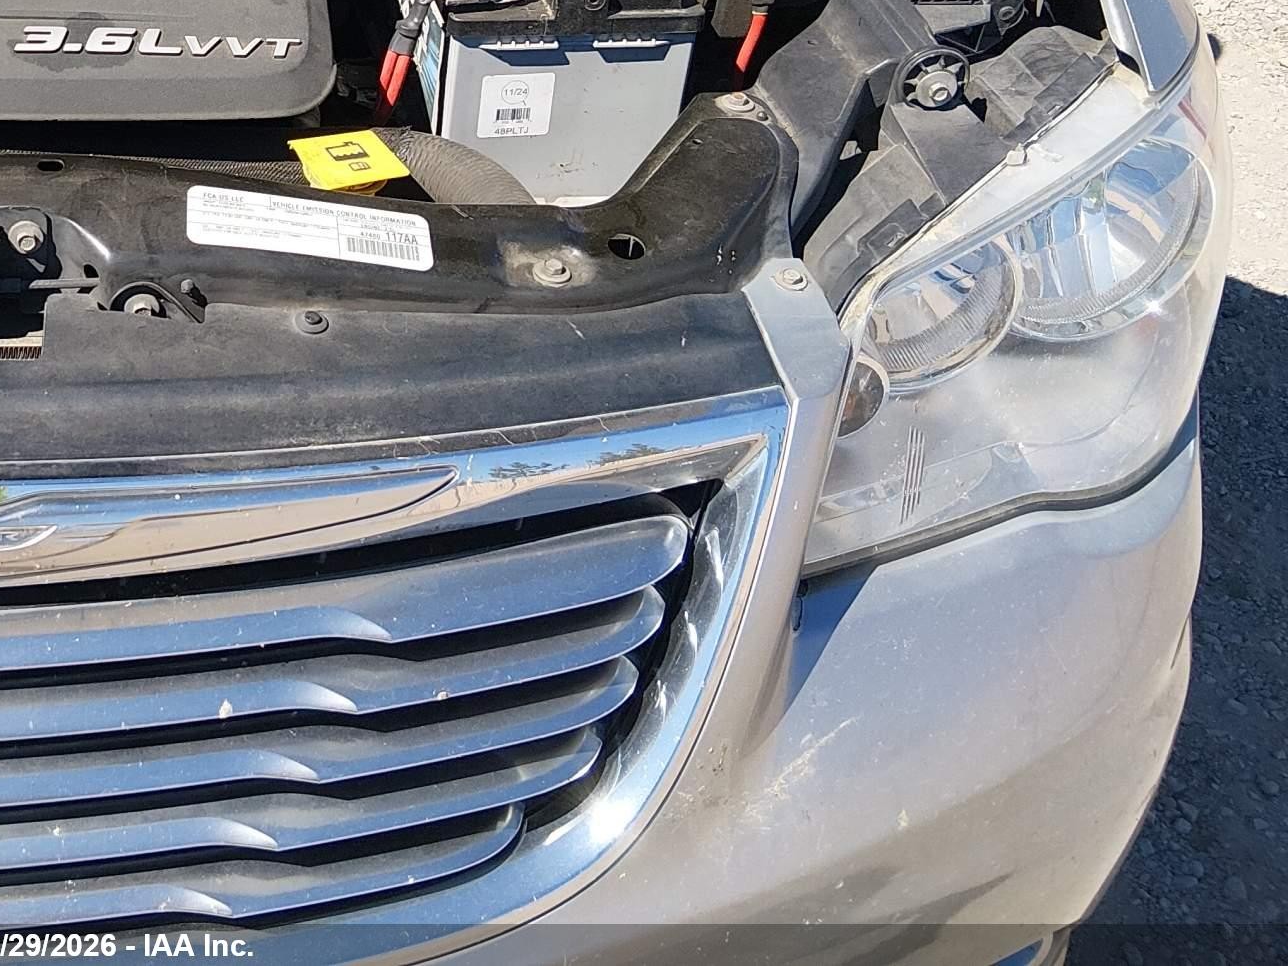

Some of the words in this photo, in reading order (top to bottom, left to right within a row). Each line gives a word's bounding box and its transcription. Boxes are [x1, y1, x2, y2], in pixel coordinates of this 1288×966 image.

[184, 35, 303, 59] VVT
[504, 88, 528, 96] 11/24
[494, 126, 529, 135] 48PLTJ
[272, 201, 299, 211] VEHICLE
[302, 205, 334, 215] EMISSION
[336, 209, 367, 220] CONTROL
[369, 214, 416, 227] INFORMATION
[386, 232, 418, 245] 117AA
